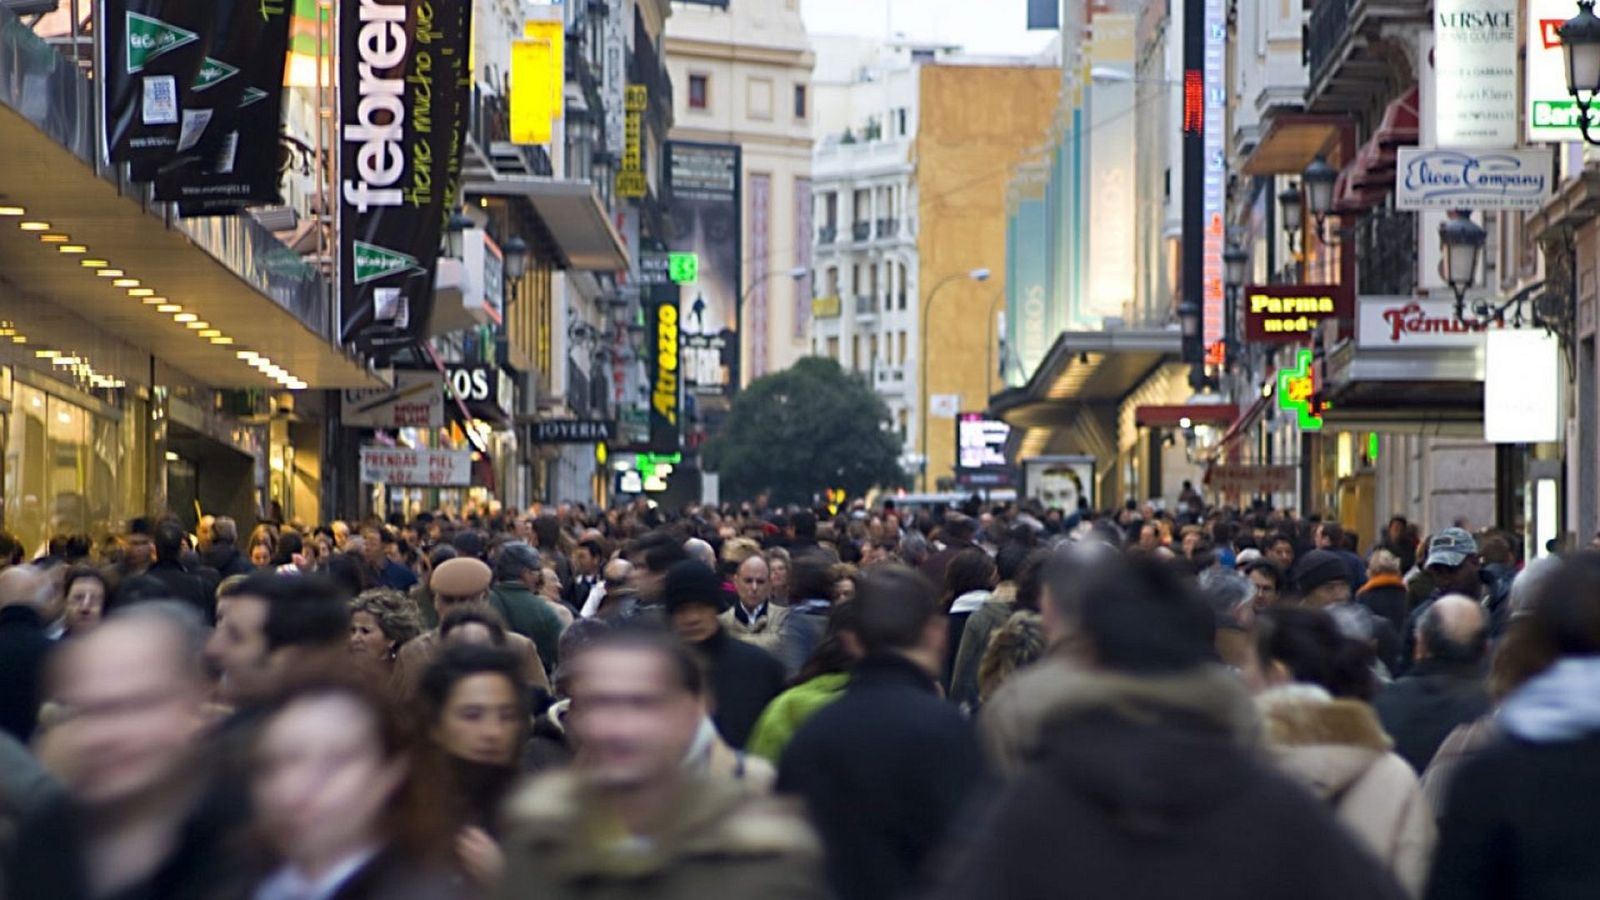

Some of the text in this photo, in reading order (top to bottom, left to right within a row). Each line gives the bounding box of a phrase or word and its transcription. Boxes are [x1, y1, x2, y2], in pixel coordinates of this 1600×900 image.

[1440, 11, 1514, 29] VERSACE
[403, 1, 444, 208] tiene mucho que
[1462, 158, 1545, 195] Company
[1251, 295, 1334, 313] Parma
[653, 304, 678, 426] Atrezzo
[539, 423, 608, 437] JOYERIA
[365, 453, 418, 466] PRENDAS
